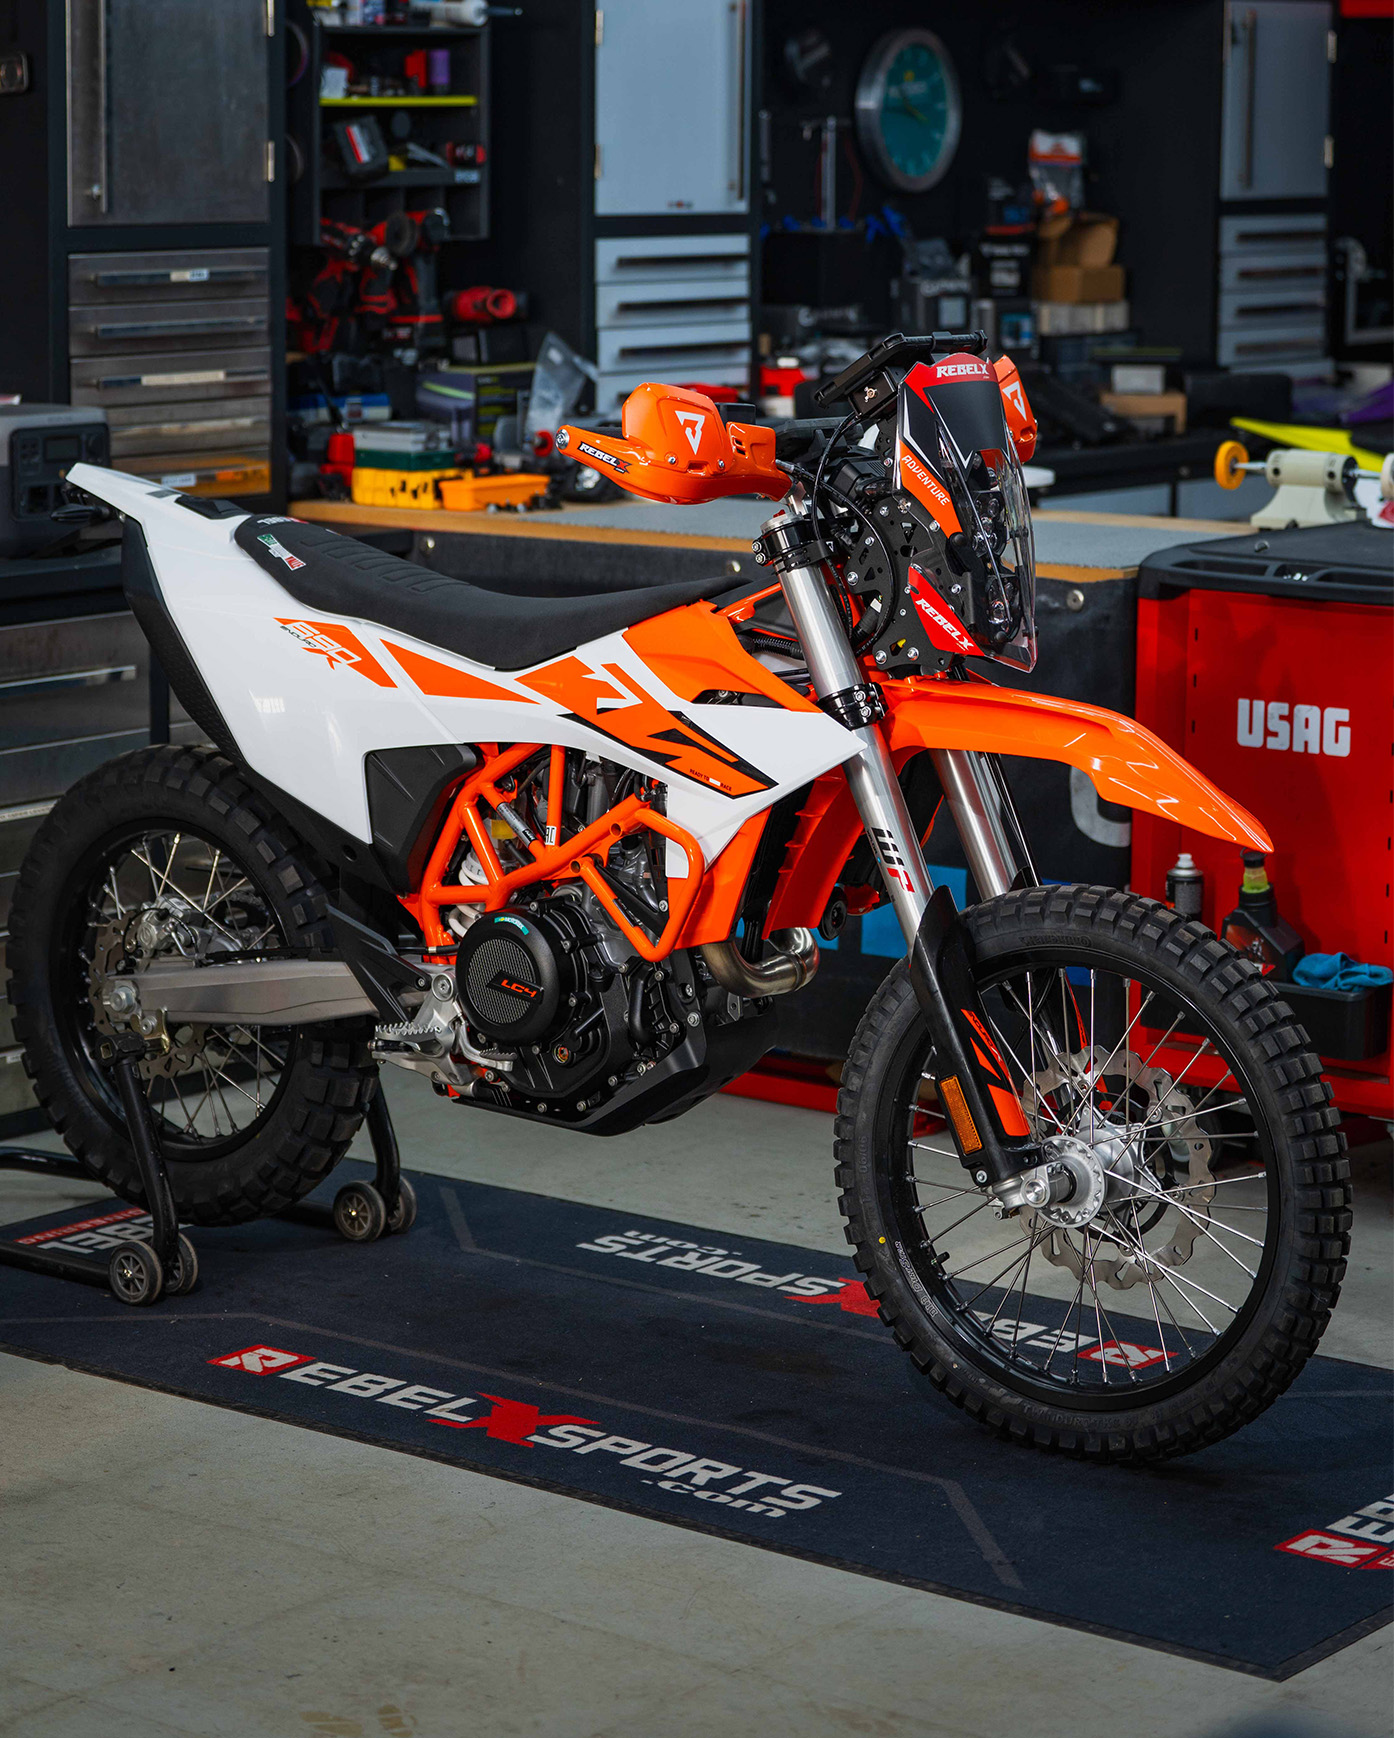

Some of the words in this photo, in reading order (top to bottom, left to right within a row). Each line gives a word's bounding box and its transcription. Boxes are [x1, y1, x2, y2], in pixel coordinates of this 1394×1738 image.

[936, 360, 989, 379] REBELX
[579, 442, 630, 472] REBELX
[901, 454, 950, 506] ADVENTURE
[285, 621, 362, 665] 690
[915, 598, 974, 651] REBELX
[1236, 697, 1352, 758] USAG
[500, 978, 538, 998] LC4
[968, 1010, 995, 1048] ENDURO
[623, 1230, 742, 1256] .com
[641, 1479, 787, 1518] .com
